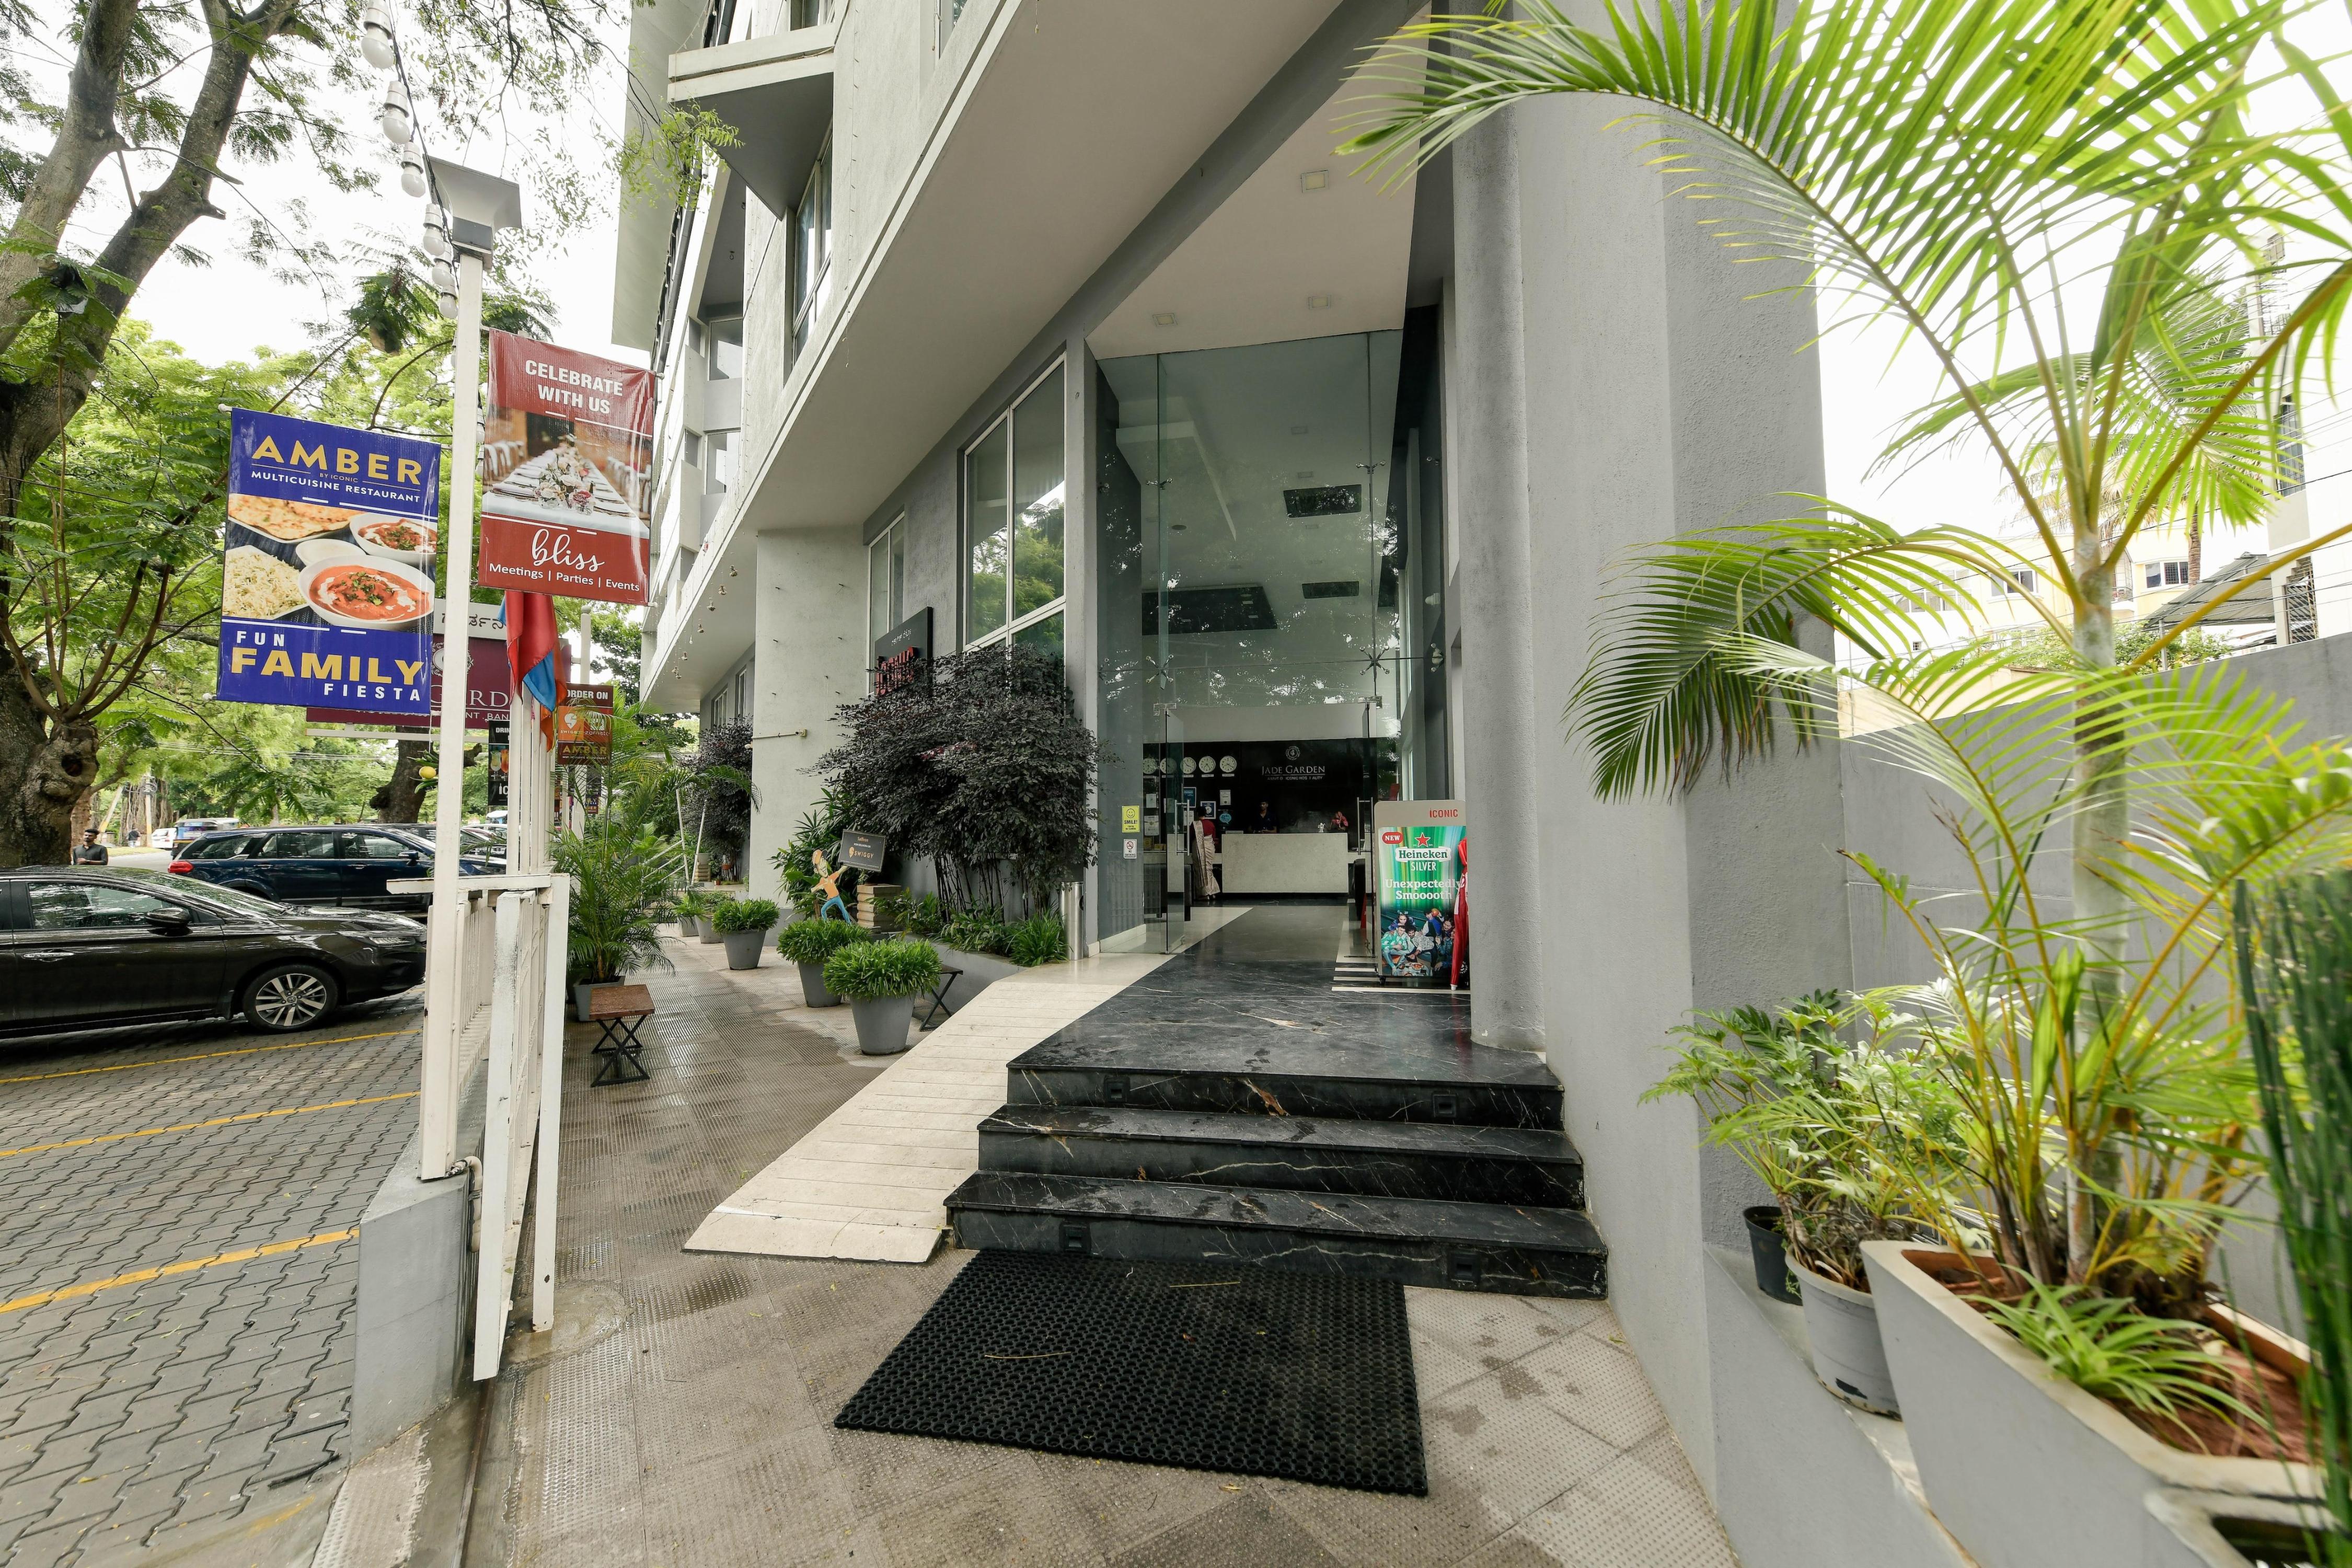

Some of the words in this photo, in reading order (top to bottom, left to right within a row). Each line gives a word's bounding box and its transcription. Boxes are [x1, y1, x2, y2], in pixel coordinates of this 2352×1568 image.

[525, 360, 623, 396] CELEBRATE
[537, 384, 583, 408] WITH
[589, 396, 610, 414] US
[251, 435, 422, 485] AMBER
[251, 470, 339, 491] MULTICUISINE
[345, 485, 420, 502] RESTAURANT
[330, 474, 359, 483] ICONIC
[532, 528, 605, 572] bliss
[489, 563, 544, 580] Meetings
[556, 572, 594, 585] Parties
[606, 579, 640, 591] Events
[237, 630, 285, 647] FUN
[231, 647, 424, 685] FAMILY
[324, 683, 420, 701] FIESTA
[1262, 766, 1282, 775] JADE
[1285, 765, 1325, 774] GARDEN
[1429, 809, 1458, 817] ICONIC
[854, 850, 874, 859] SWIGGY
[1399, 849, 1448, 859] Heineken
[1411, 861, 1437, 871] SILVER
[1385, 879, 1461, 891] Unexpectedly
